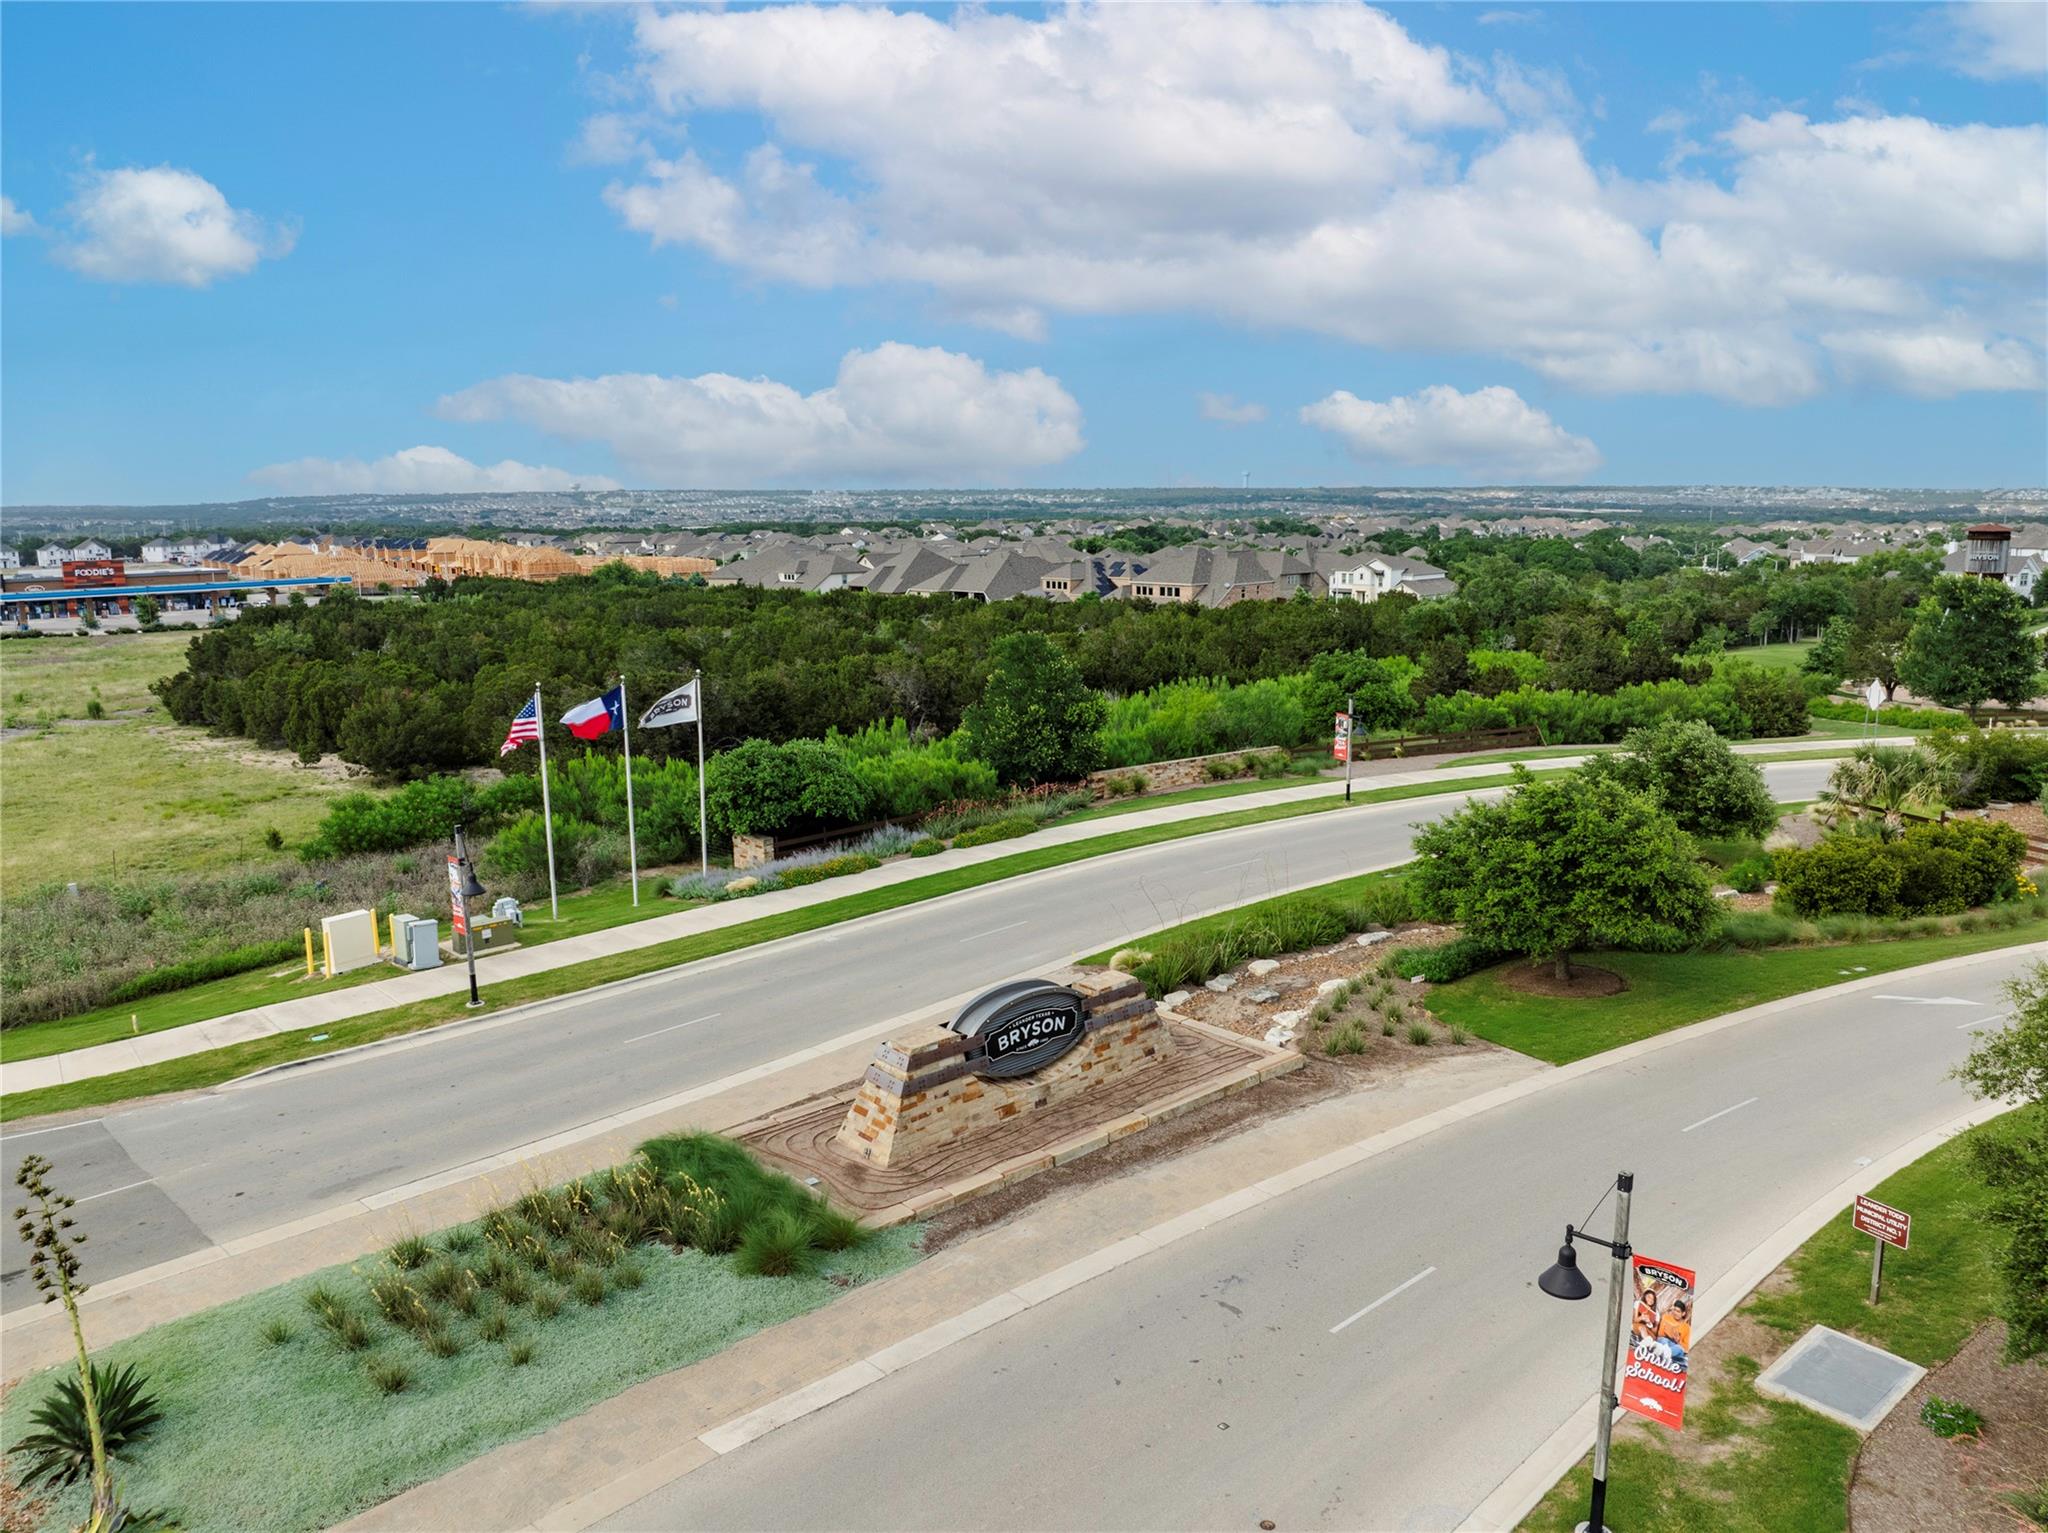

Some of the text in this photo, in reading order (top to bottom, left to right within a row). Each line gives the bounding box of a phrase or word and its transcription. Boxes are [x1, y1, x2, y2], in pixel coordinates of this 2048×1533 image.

[74, 567, 115, 577] FOODIE'S
[649, 697, 688, 720] BRYSON
[997, 1015, 1067, 1052] BRYSON
[1856, 1205, 1886, 1222] MUNICIPAL
[1886, 1218, 1907, 1231] UTILITY
[1860, 1198, 1905, 1221] LEANDER TODD
[1860, 1215, 1886, 1230] DISTRICT
[1644, 1267, 1683, 1287] BRYSON
[1634, 1344, 1682, 1374] Onsite
[1626, 1362, 1685, 1393] School!
